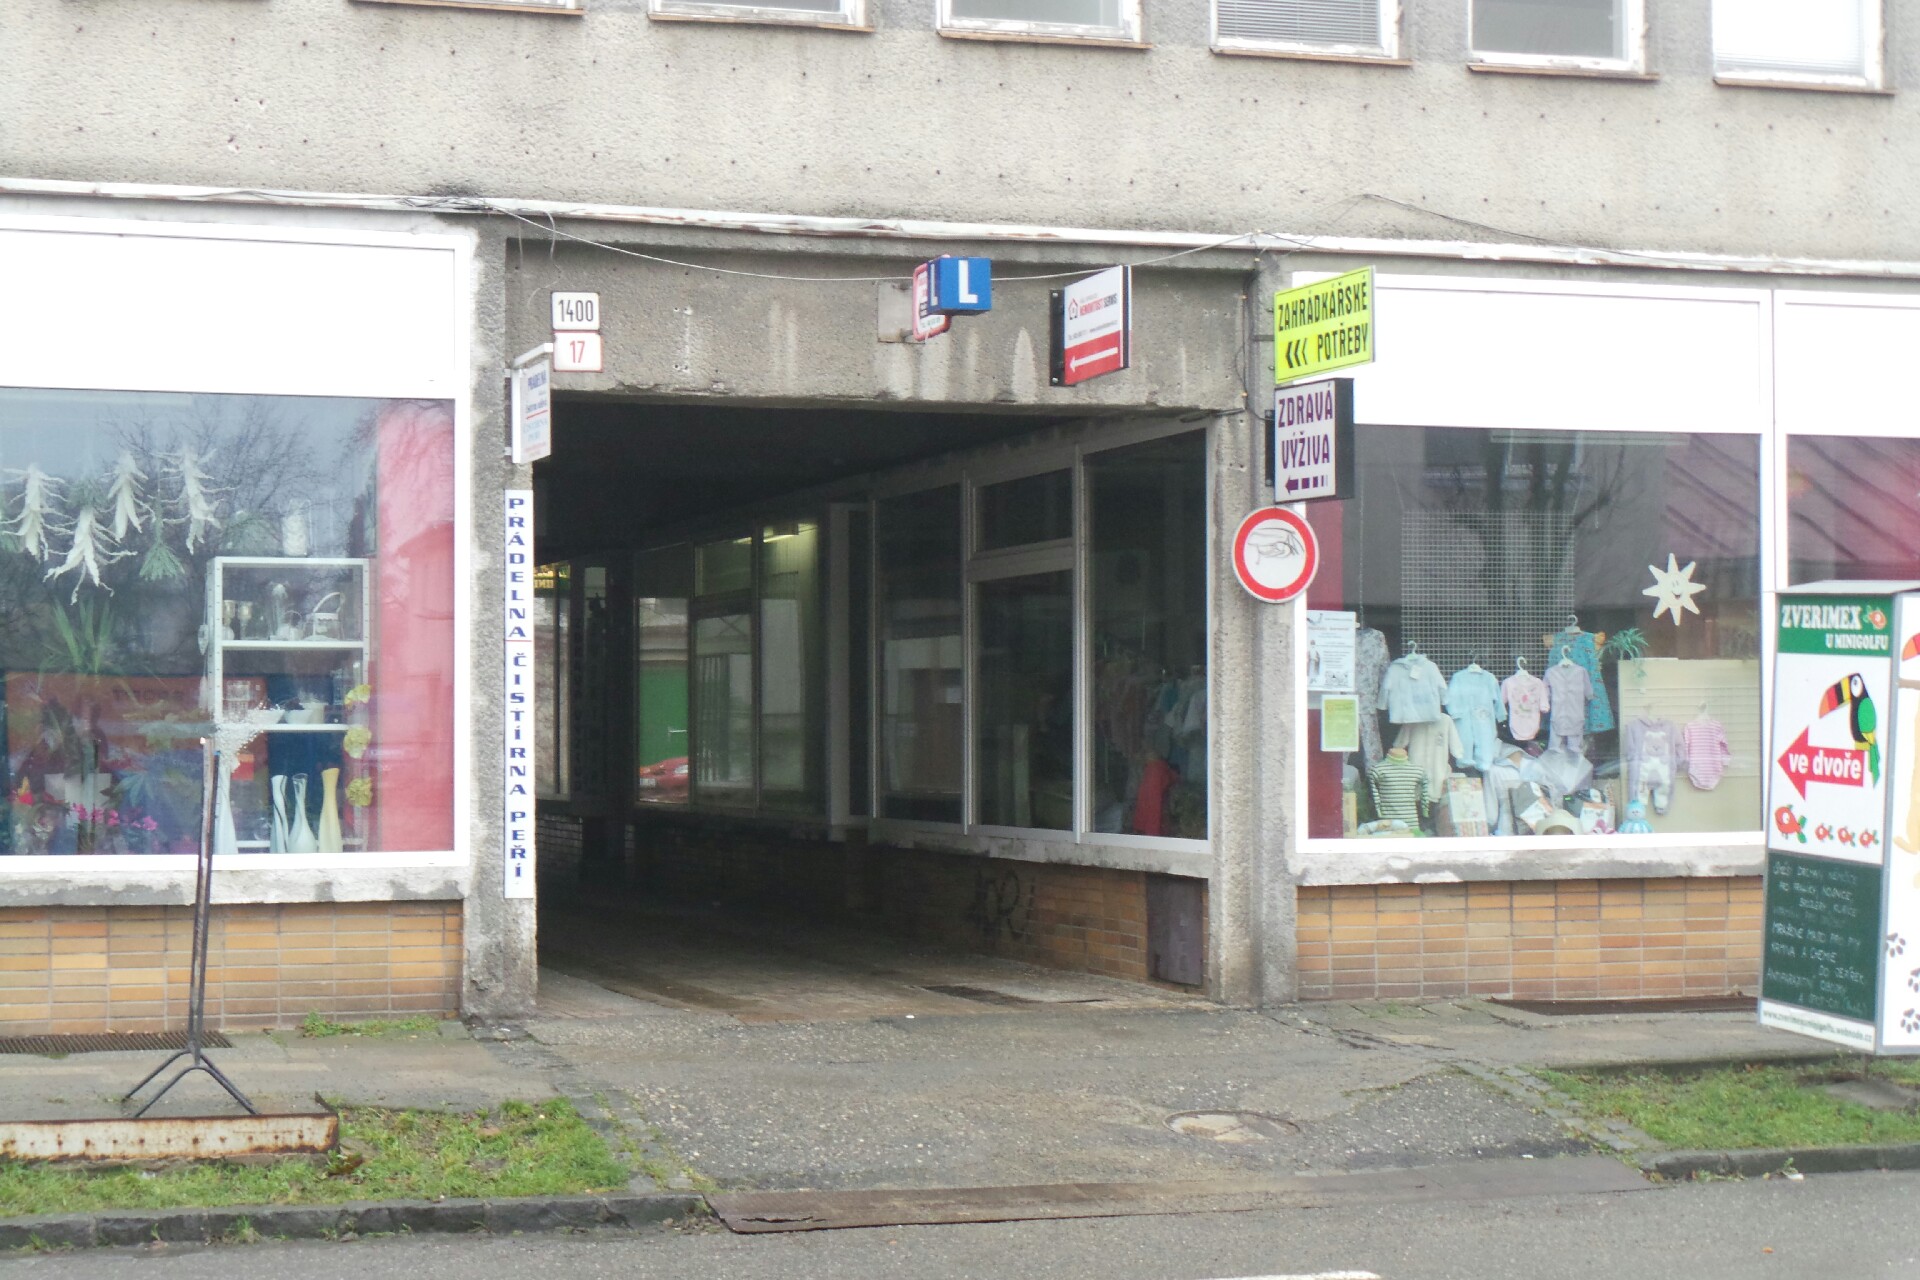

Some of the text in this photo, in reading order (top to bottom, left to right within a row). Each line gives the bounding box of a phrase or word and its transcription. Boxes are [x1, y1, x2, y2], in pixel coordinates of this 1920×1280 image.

[958, 260, 978, 304] L
[558, 299, 594, 322] 1400
[1278, 275, 1368, 332] ZAHRÁDKÁŘSKÉ
[570, 340, 586, 363] 17
[1317, 322, 1368, 362] POTŘEBY
[1278, 382, 1333, 428] ZDRAVÁ
[1281, 430, 1330, 470] VÝŽIVA
[508, 498, 527, 638] PRÁDELNA
[1781, 604, 1863, 630] ZVERIMEX
[1825, 633, 1889, 650] U MINIGOLFU
[509, 653, 527, 796] ČISTÍRNA
[1788, 749, 1862, 780] ve dvoře
[510, 811, 527, 878] PEŘÍ
